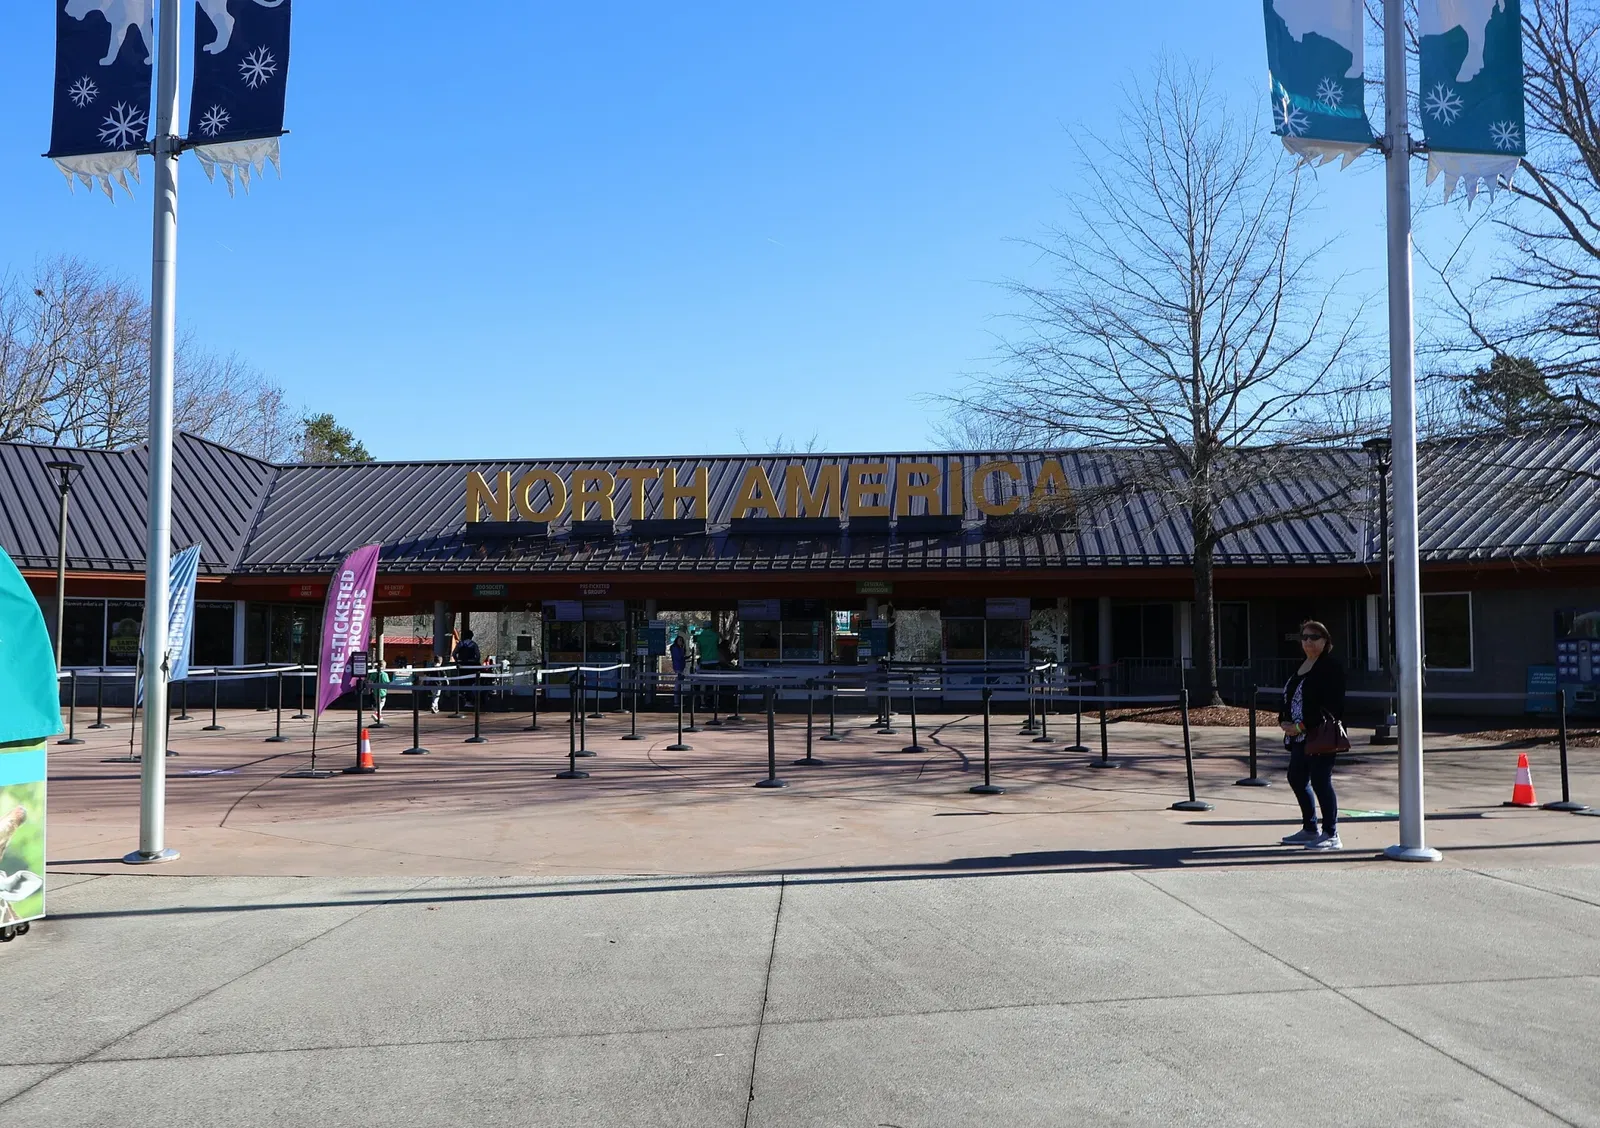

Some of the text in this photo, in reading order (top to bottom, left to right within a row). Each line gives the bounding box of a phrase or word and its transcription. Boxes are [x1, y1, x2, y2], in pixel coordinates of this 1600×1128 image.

[465, 458, 1078, 523] NORTH AMERICA
[329, 569, 355, 685] PRE-TICKETED
[347, 588, 367, 657] GROUPS
